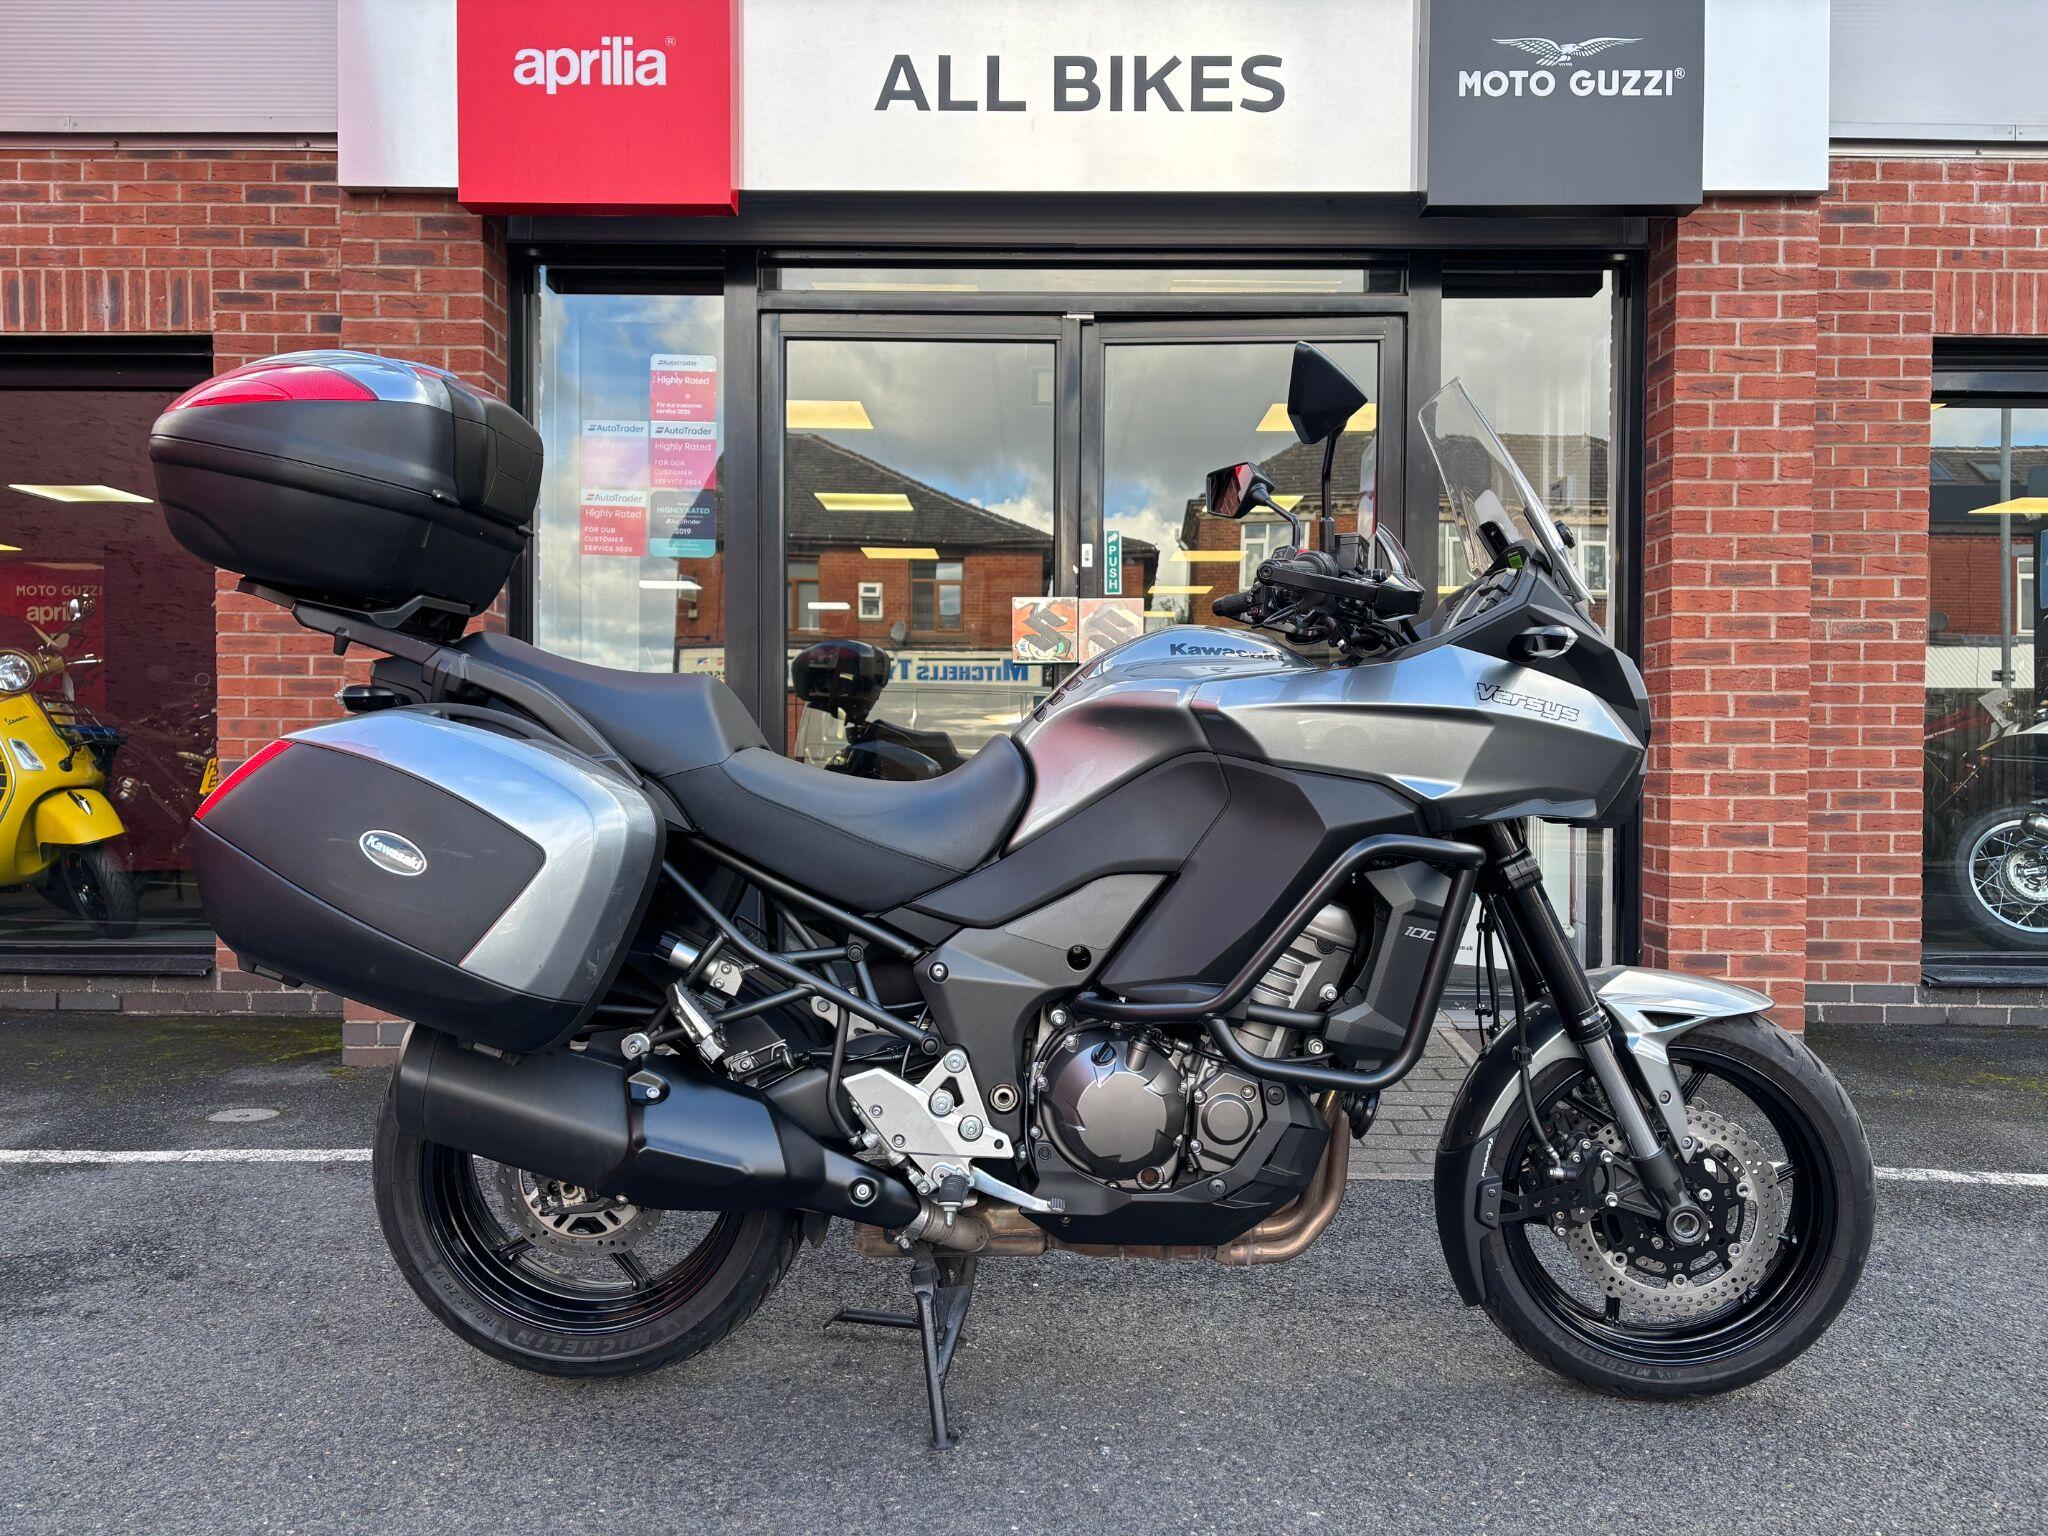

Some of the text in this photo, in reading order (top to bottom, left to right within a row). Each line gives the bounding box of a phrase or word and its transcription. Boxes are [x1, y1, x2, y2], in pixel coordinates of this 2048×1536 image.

[874, 54, 1286, 113] ALL BIKES
[1458, 70, 1556, 97] MOTO
[656, 376, 710, 386] Highly Rated
[596, 424, 644, 433] AutoTrader
[664, 426, 712, 435] AutoTrader
[654, 442, 683, 452] Highly
[684, 442, 711, 451] Rated
[594, 493, 643, 502] AutoTrader
[585, 508, 642, 519] Highly Rated
[656, 506, 710, 515] HIGHLY RATED
[1108, 545, 1118, 590] PUSH
[16, 585, 103, 597] MOTO GUZZI
[431, 1269, 497, 1328] 180/55 ZR 17
[512, 1328, 651, 1355] MICHELIN
